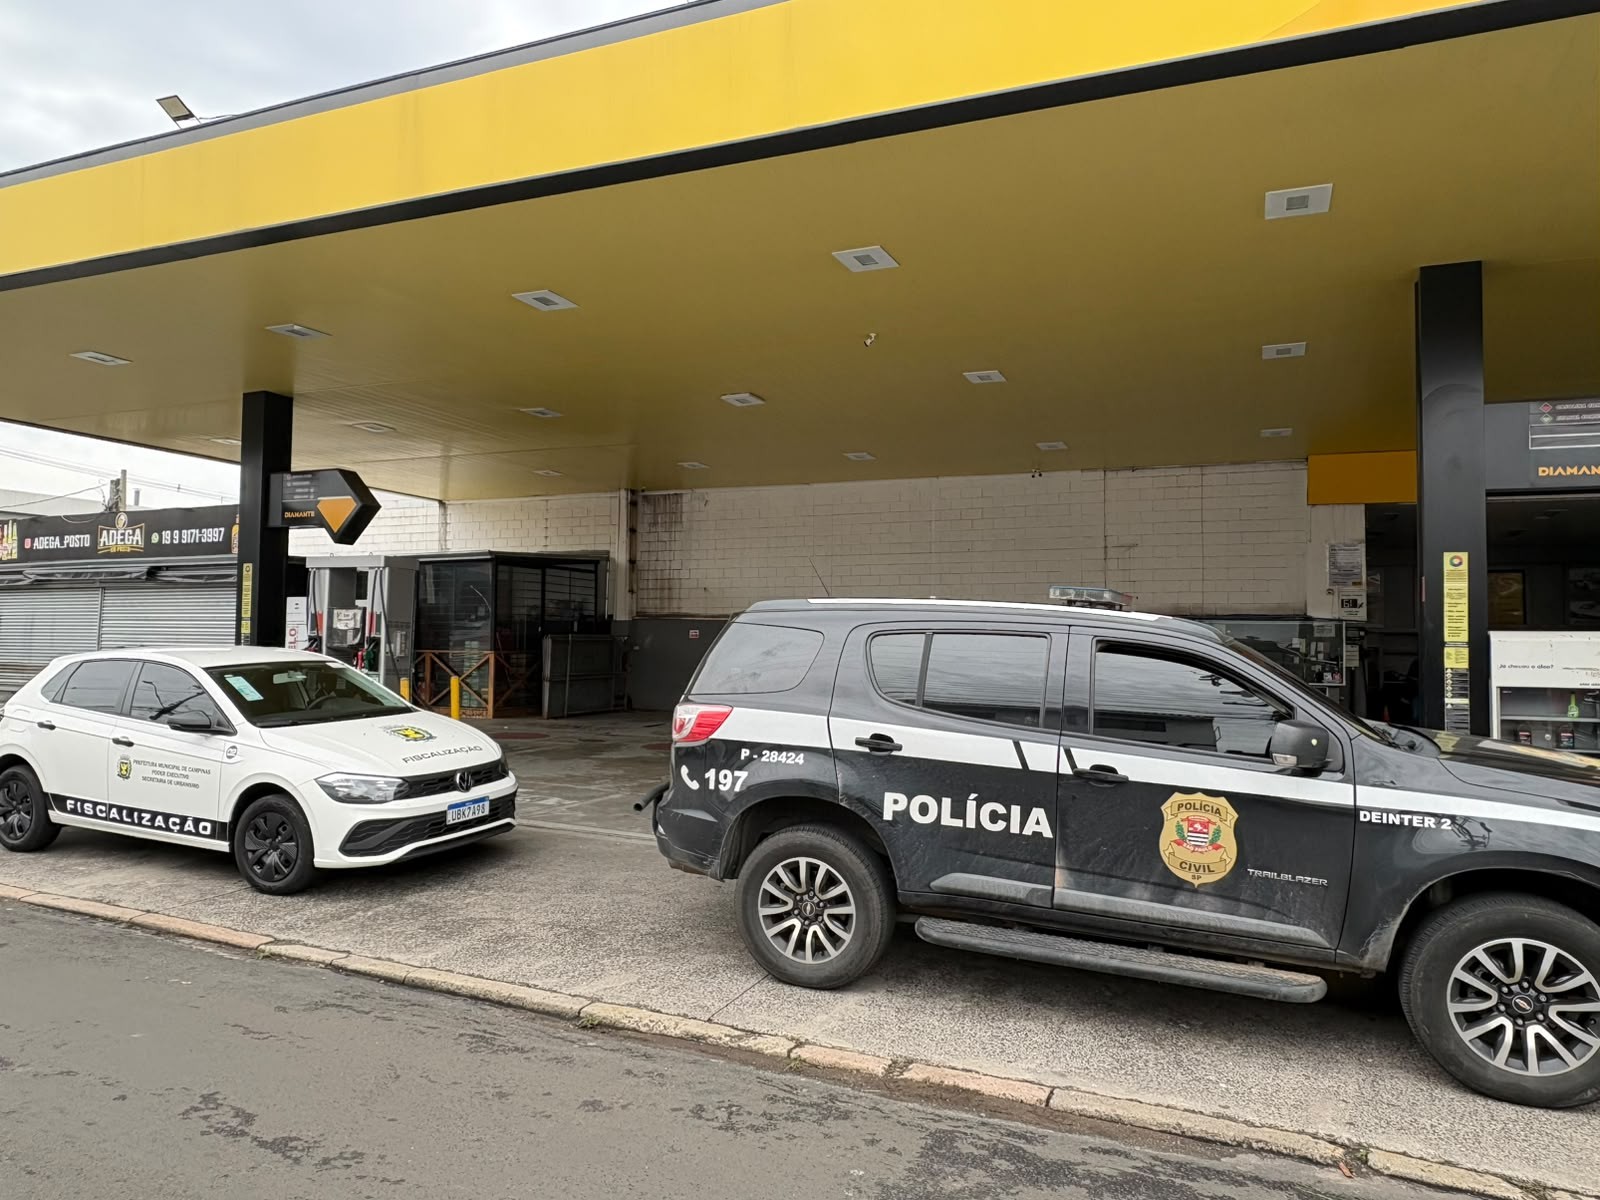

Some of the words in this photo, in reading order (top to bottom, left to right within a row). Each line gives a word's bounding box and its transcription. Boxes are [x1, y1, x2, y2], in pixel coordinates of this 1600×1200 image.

[284, 510, 315, 518] DIAMANTE
[33, 534, 90, 550] ADEGA_POSTO
[99, 528, 142, 547] ADEGA
[161, 530, 171, 544] 19
[172, 529, 179, 544] 9
[181, 527, 225, 544] 9171-3997
[740, 748, 750, 760] P
[760, 750, 805, 765] 28424
[188, 767, 211, 775] CAMPINAS
[704, 768, 749, 792] 197
[66, 799, 212, 836] FISCALIZAÇÃO
[882, 791, 1054, 838] POLÍCIA
[1177, 801, 1222, 817] POLÍCIA
[1359, 810, 1436, 828] DEINTER
[1440, 817, 1452, 830] 2
[1179, 861, 1215, 873] CIVIL
[1191, 873, 1202, 881] SP
[1247, 868, 1328, 886] TRAILBLAZER
